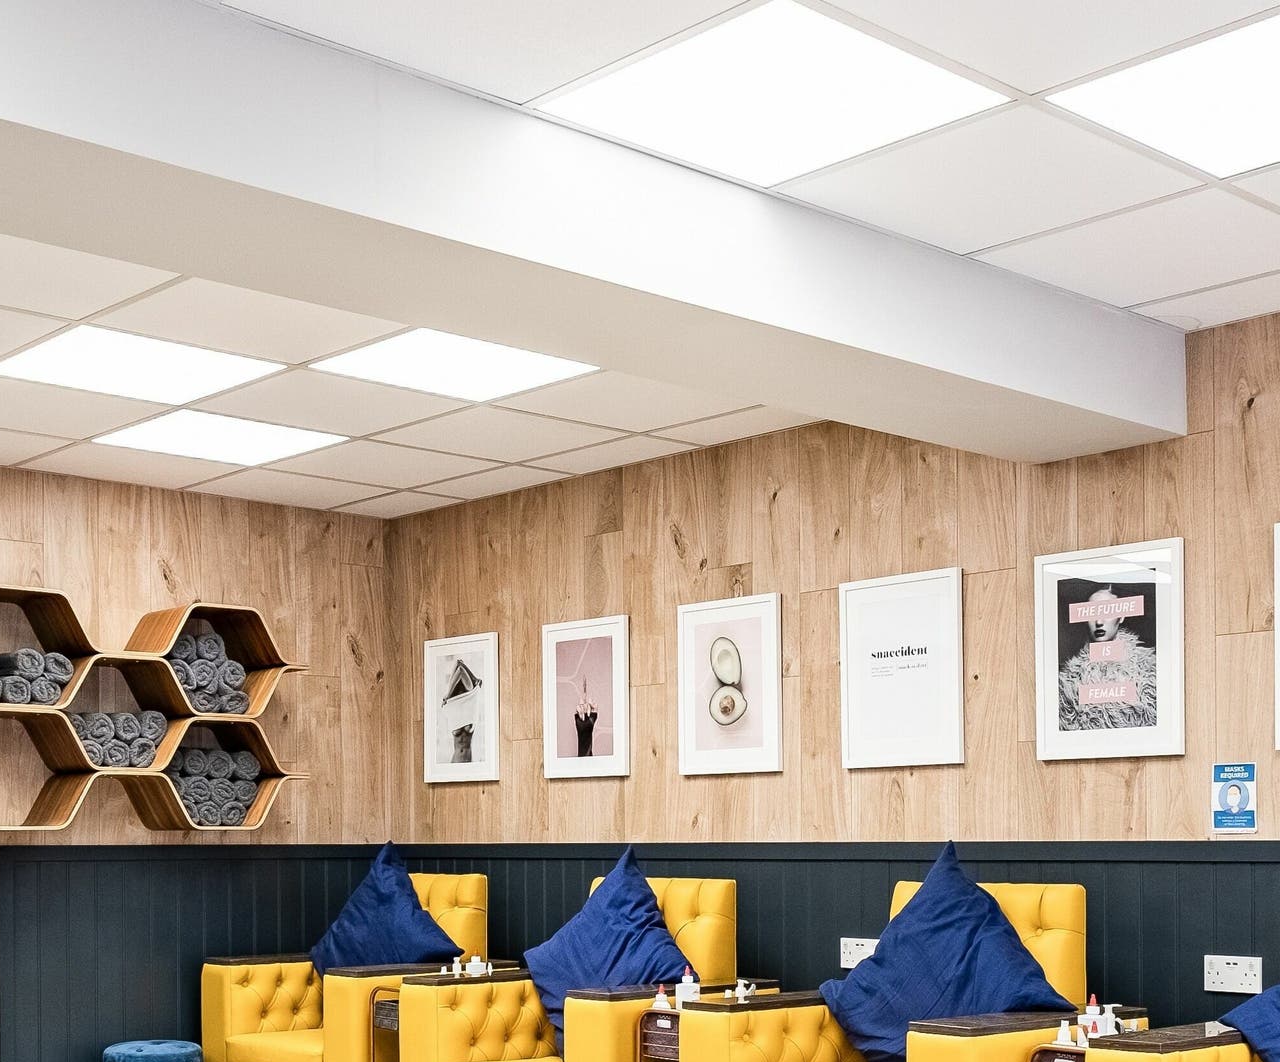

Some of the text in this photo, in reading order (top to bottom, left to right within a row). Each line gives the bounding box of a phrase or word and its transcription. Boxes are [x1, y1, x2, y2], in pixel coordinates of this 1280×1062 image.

[1076, 601, 1136, 617] THE FUTURE
[871, 645, 928, 659] snaccident
[1102, 646, 1111, 657] IS
[1088, 686, 1127, 699] FEMALE
